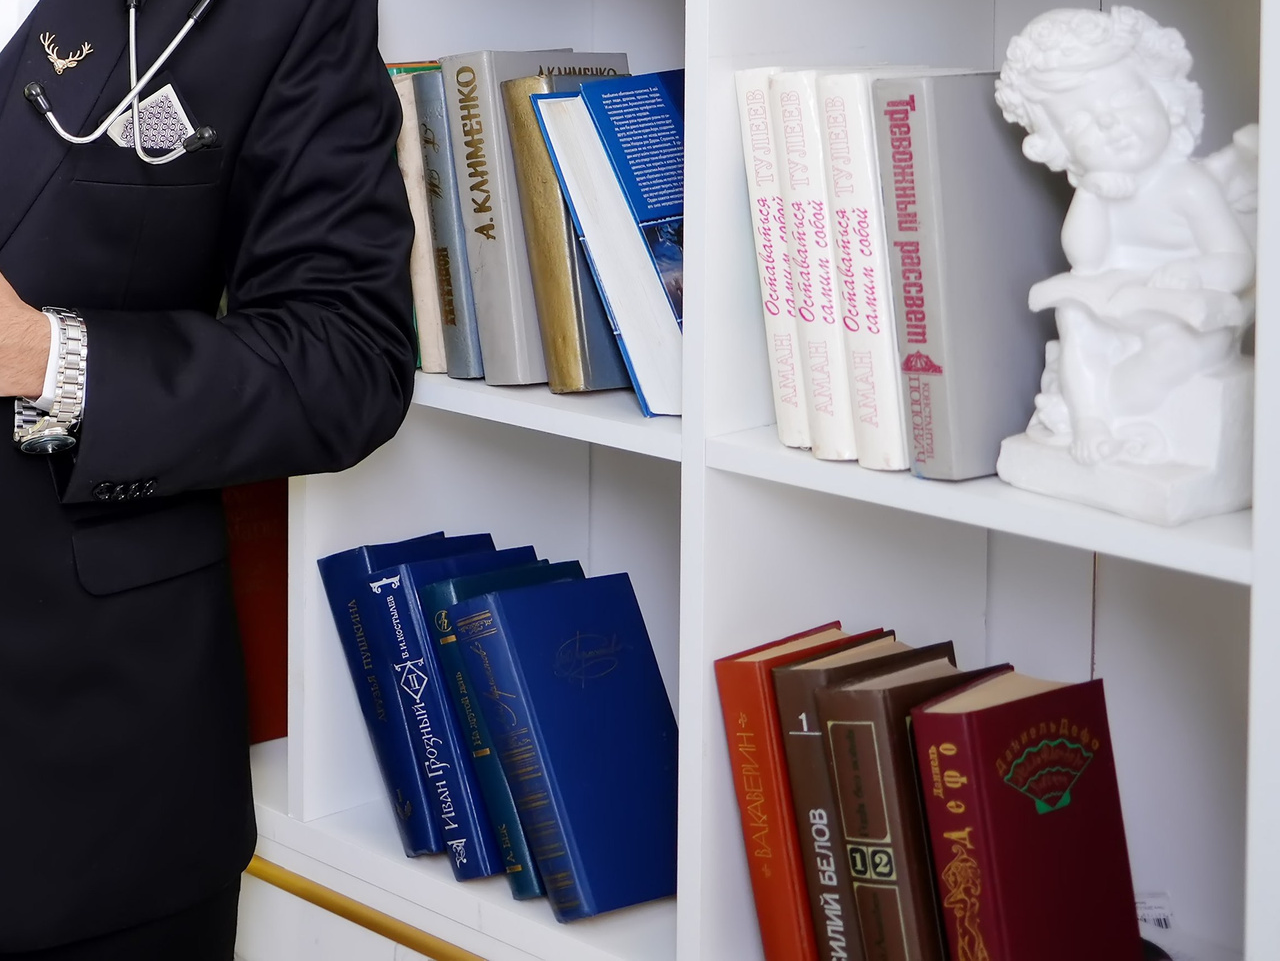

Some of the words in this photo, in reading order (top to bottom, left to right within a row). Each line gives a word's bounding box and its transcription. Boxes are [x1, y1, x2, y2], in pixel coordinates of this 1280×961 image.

[455, 65, 492, 214] КЛИМЕНКО
[746, 88, 774, 188] ТУЛЕЕВ
[780, 89, 809, 190] ТУЛЕЕВ
[824, 95, 855, 199] ТУЛЕЕВ
[884, 93, 919, 234] Тревожный
[474, 216, 497, 240] А.
[757, 196, 781, 317] Оставаться
[788, 200, 815, 324] Оставаться
[814, 199, 828, 249] собой
[857, 206, 874, 258] собой
[822, 257, 836, 326] самим
[834, 207, 860, 333] Оставаться
[866, 266, 881, 336] самим
[893, 239, 928, 345] рассвет
[773, 333, 798, 408] АМАН
[807, 339, 834, 417] АМАН
[847, 349, 879, 430] АМАН
[908, 376, 927, 464] ПОПОВИЧ
[922, 381, 935, 461] КОНСТАНТИН
[347, 598, 373, 670] ПУШКИНА
[366, 676, 388, 723] ДРУЗЬЯ
[455, 670, 467, 695] день
[459, 697, 477, 731] другой
[471, 729, 482, 747] На
[799, 713, 810, 731] 1
[1058, 718, 1101, 751] Дефо
[938, 742, 976, 850] Дефо
[809, 808, 839, 887] БЕЛОВ
